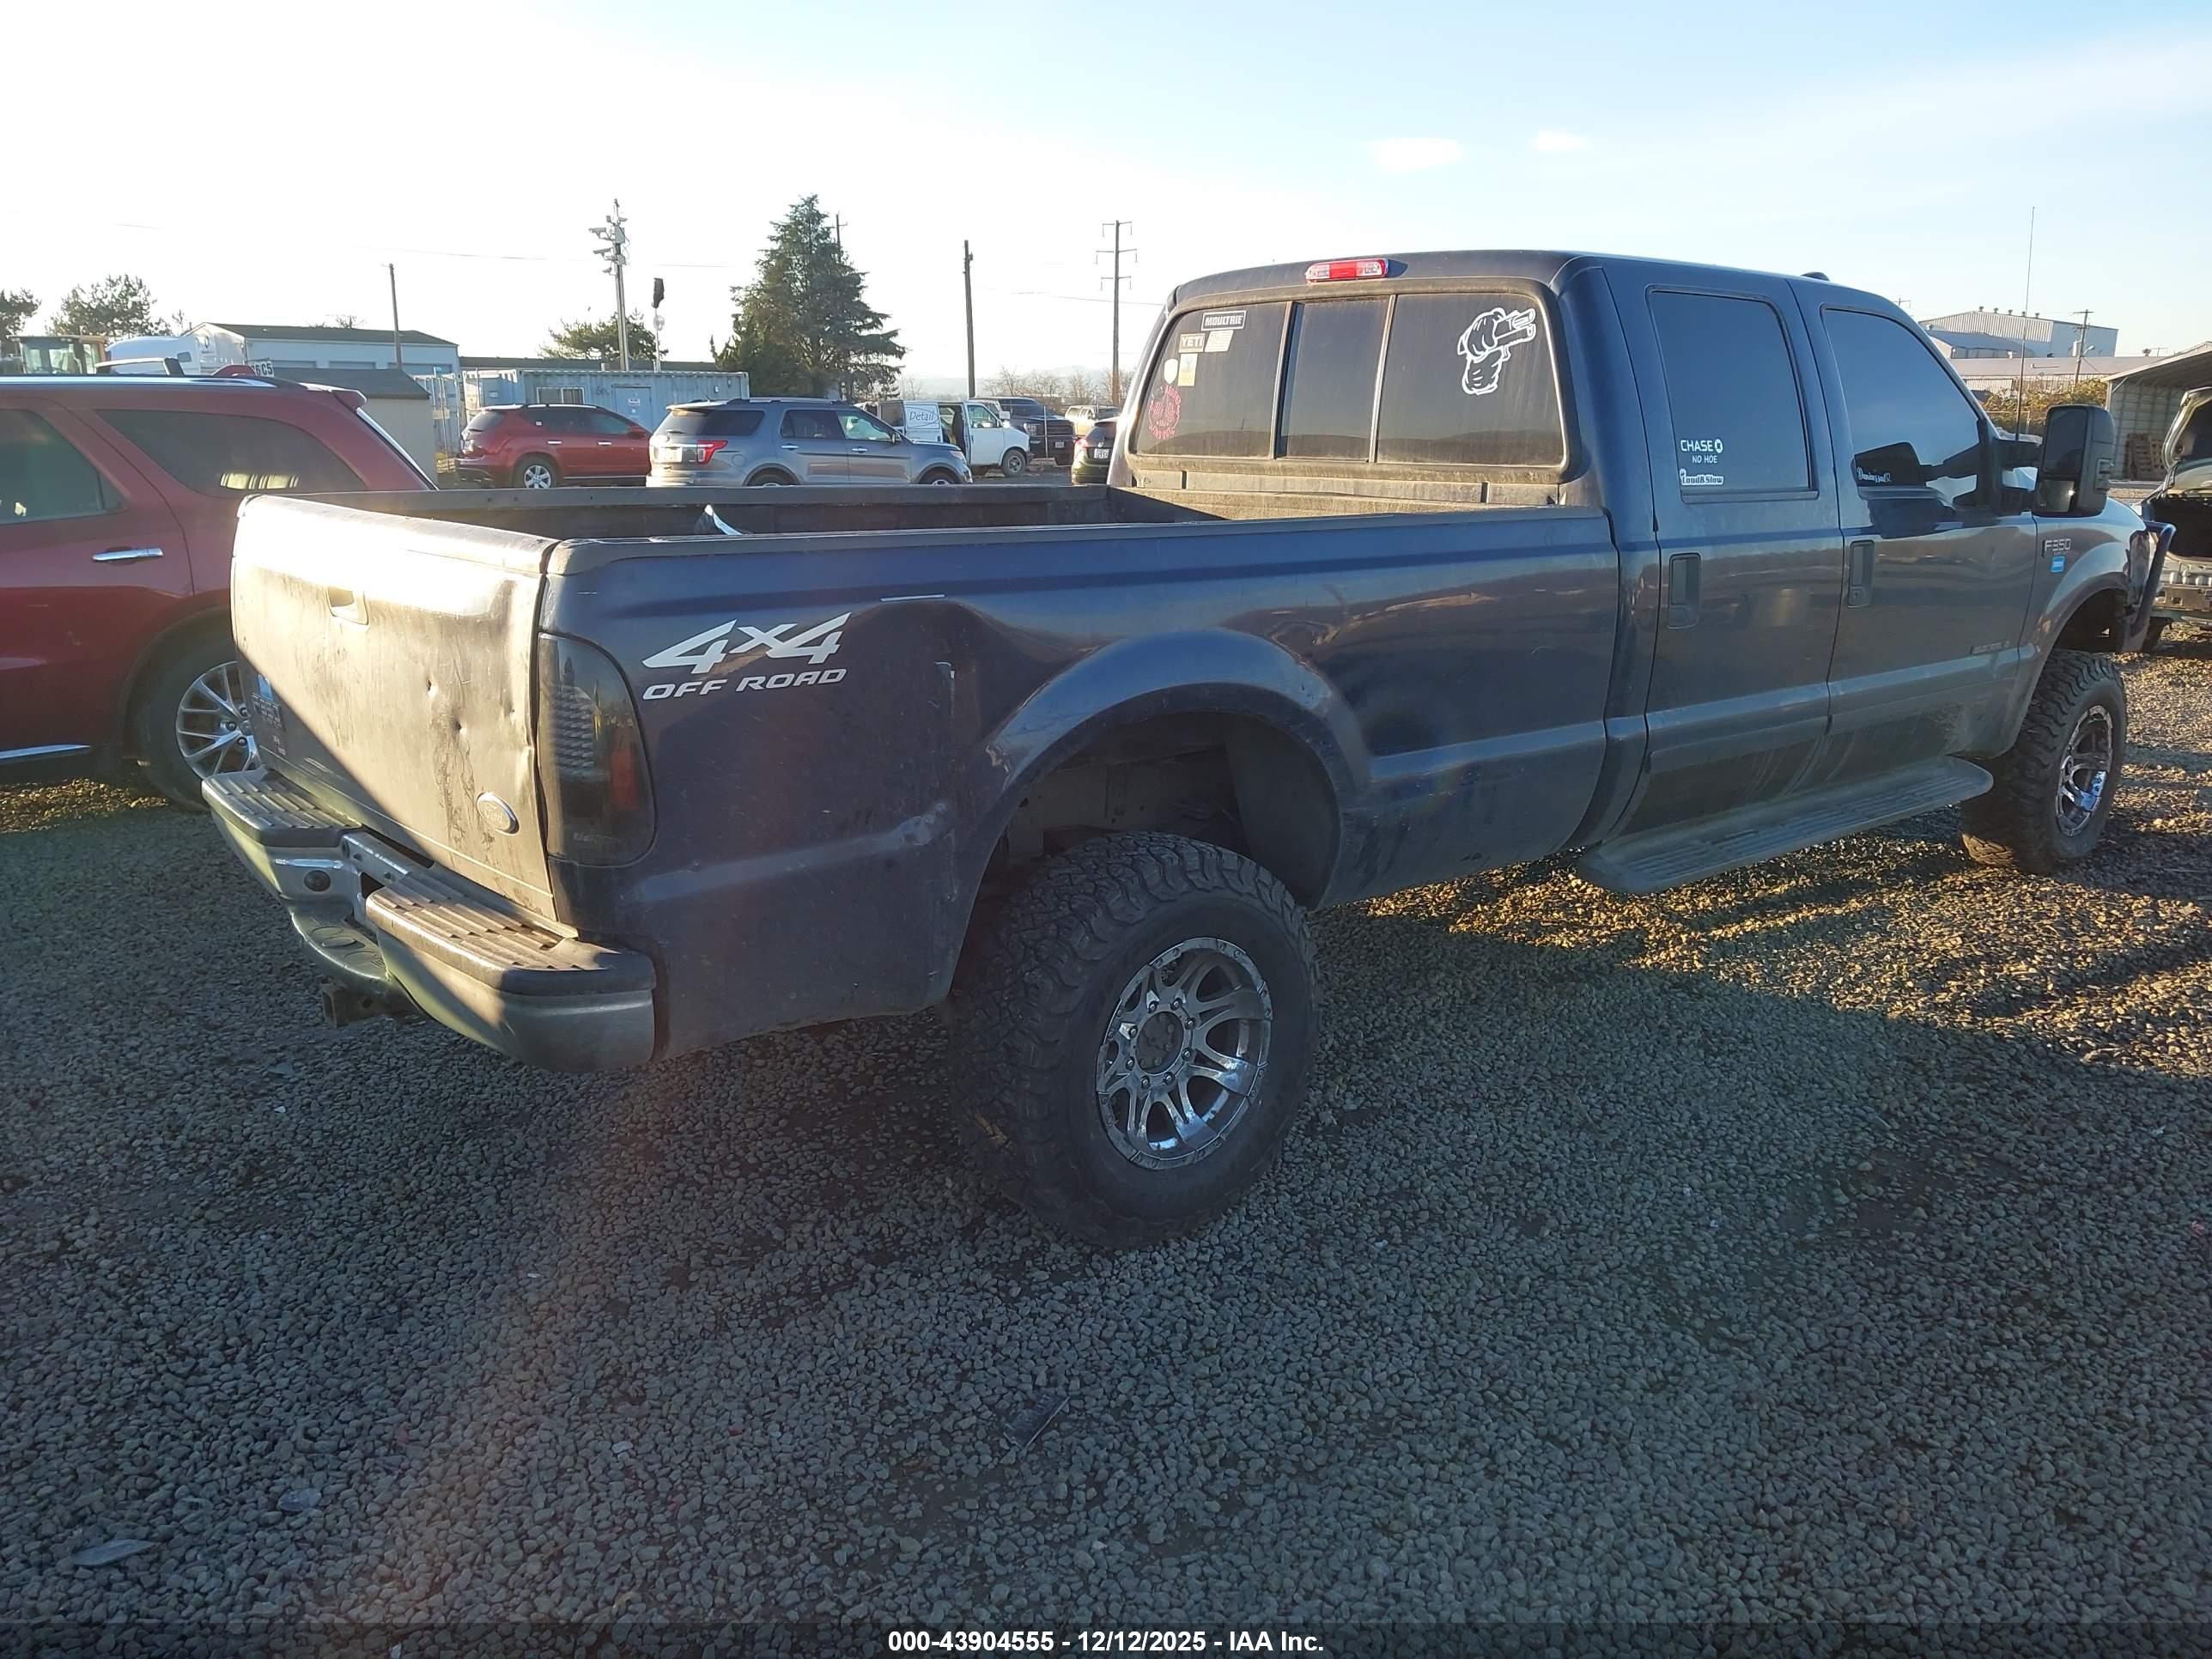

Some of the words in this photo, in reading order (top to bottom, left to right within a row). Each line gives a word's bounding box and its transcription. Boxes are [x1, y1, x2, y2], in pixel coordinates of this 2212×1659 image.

[1205, 315, 1243, 326] MOULTRIE
[1182, 336, 1205, 347] YETI
[909, 411, 934, 421] Detail
[1680, 440, 1714, 452] CHASE
[1692, 455, 1702, 464] NO
[1704, 455, 1718, 464] HOE
[2045, 538, 2071, 552] F350
[642, 679, 728, 700] OFF
[735, 669, 848, 692] ROAD
